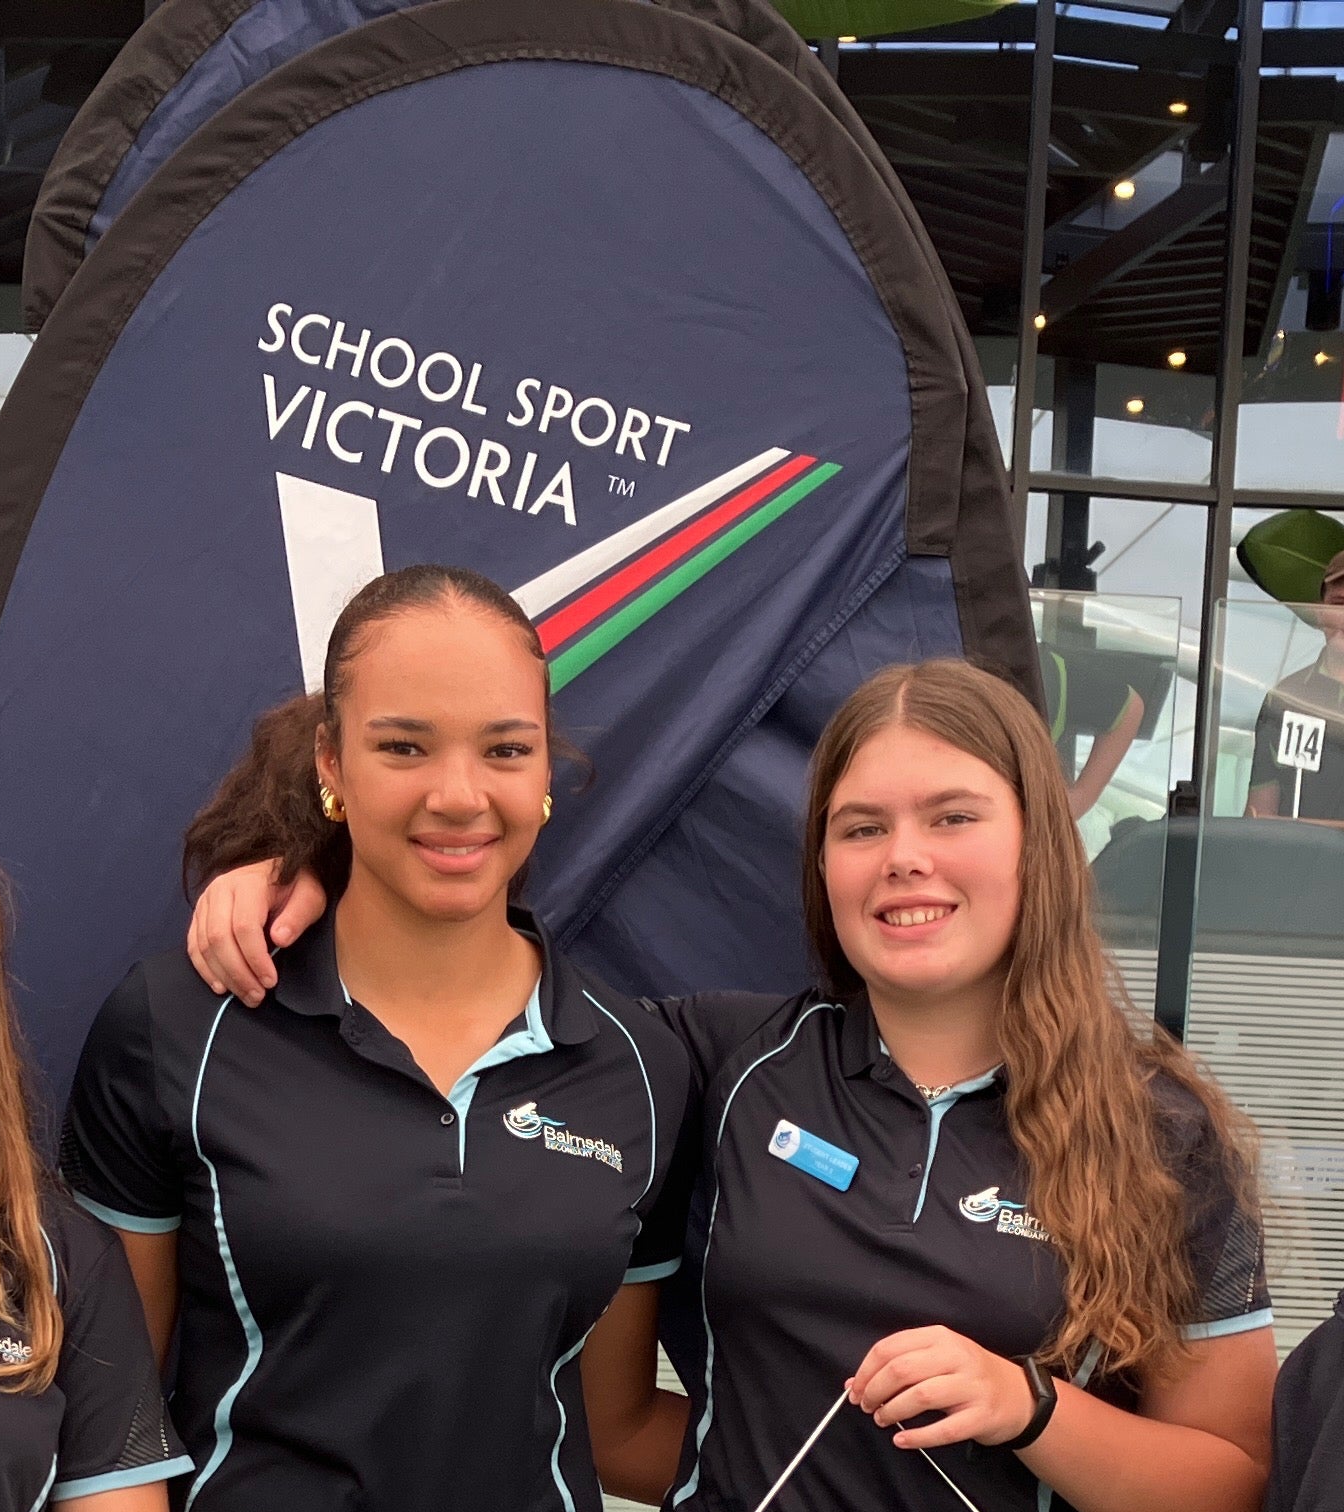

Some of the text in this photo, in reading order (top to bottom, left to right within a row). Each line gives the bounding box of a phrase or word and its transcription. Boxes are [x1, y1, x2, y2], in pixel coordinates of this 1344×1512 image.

[258, 302, 692, 467] SCHOOL SPORT
[262, 372, 578, 527] VICTORIA
[1284, 721, 1319, 762] 114
[999, 1208, 1045, 1232] Bairn
